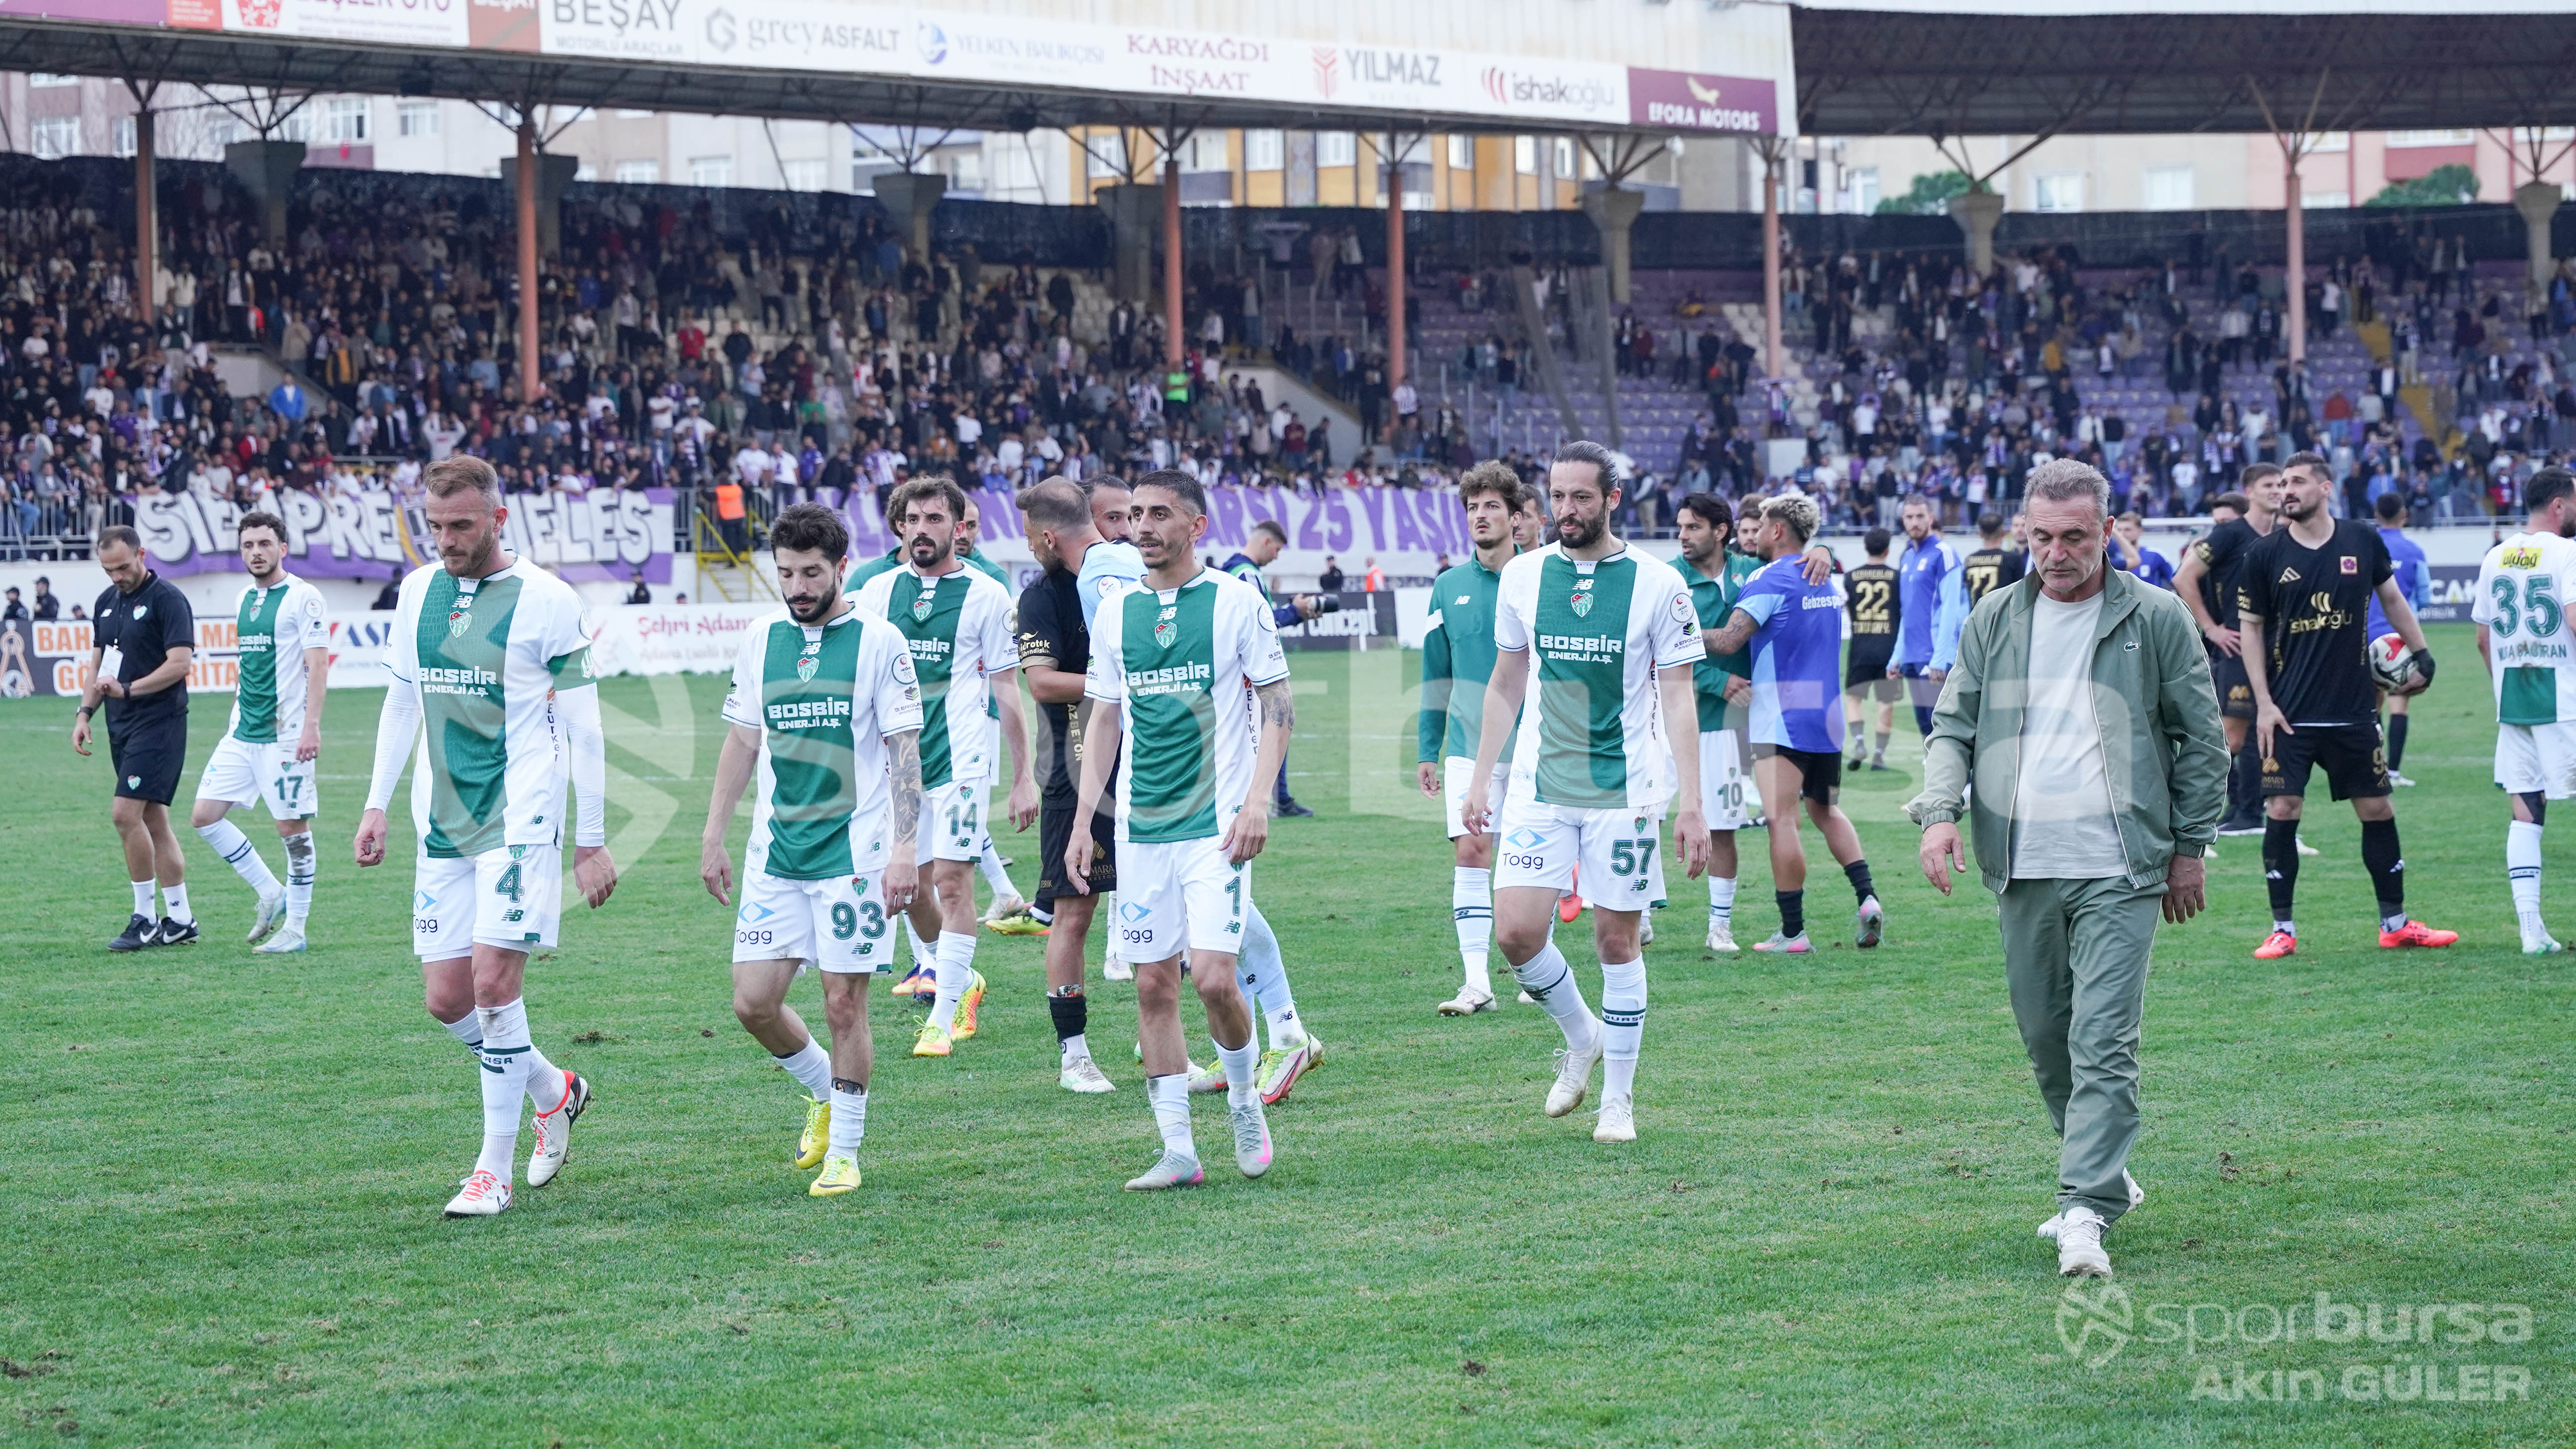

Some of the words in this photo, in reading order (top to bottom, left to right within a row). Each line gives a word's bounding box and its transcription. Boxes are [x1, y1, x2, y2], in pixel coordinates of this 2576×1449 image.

[1127, 34, 1269, 63] KARYAĞDI
[1151, 65, 1249, 94] İNŞAAT
[1346, 48, 1441, 86] YILMAZ
[1648, 101, 1695, 126] EFORA
[1697, 106, 1761, 132] MOTORS
[1856, 580, 1890, 621] 22
[2492, 574, 2562, 638] 35
[906, 637, 951, 654] SBİR
[1539, 634, 1622, 653] BOSBİR
[1548, 650, 1590, 662] ENERJİ
[419, 665, 497, 685] BOSBİR
[1127, 660, 1211, 687] BOSBİR
[424, 683, 467, 695] ENERJİ
[1136, 681, 1181, 697] ENERJİ
[767, 696, 850, 720] BOSBİR
[777, 716, 820, 730] ENERJİ
[274, 775, 303, 801] 17
[1717, 782, 1743, 810] 10
[945, 802, 977, 836] 14
[1502, 852, 1543, 869] Togg
[1610, 838, 1656, 876] 57
[495, 863, 525, 903] 4
[1225, 876, 1241, 917] 1
[830, 900, 887, 941] 93
[483, 1056, 513, 1065] RSA
